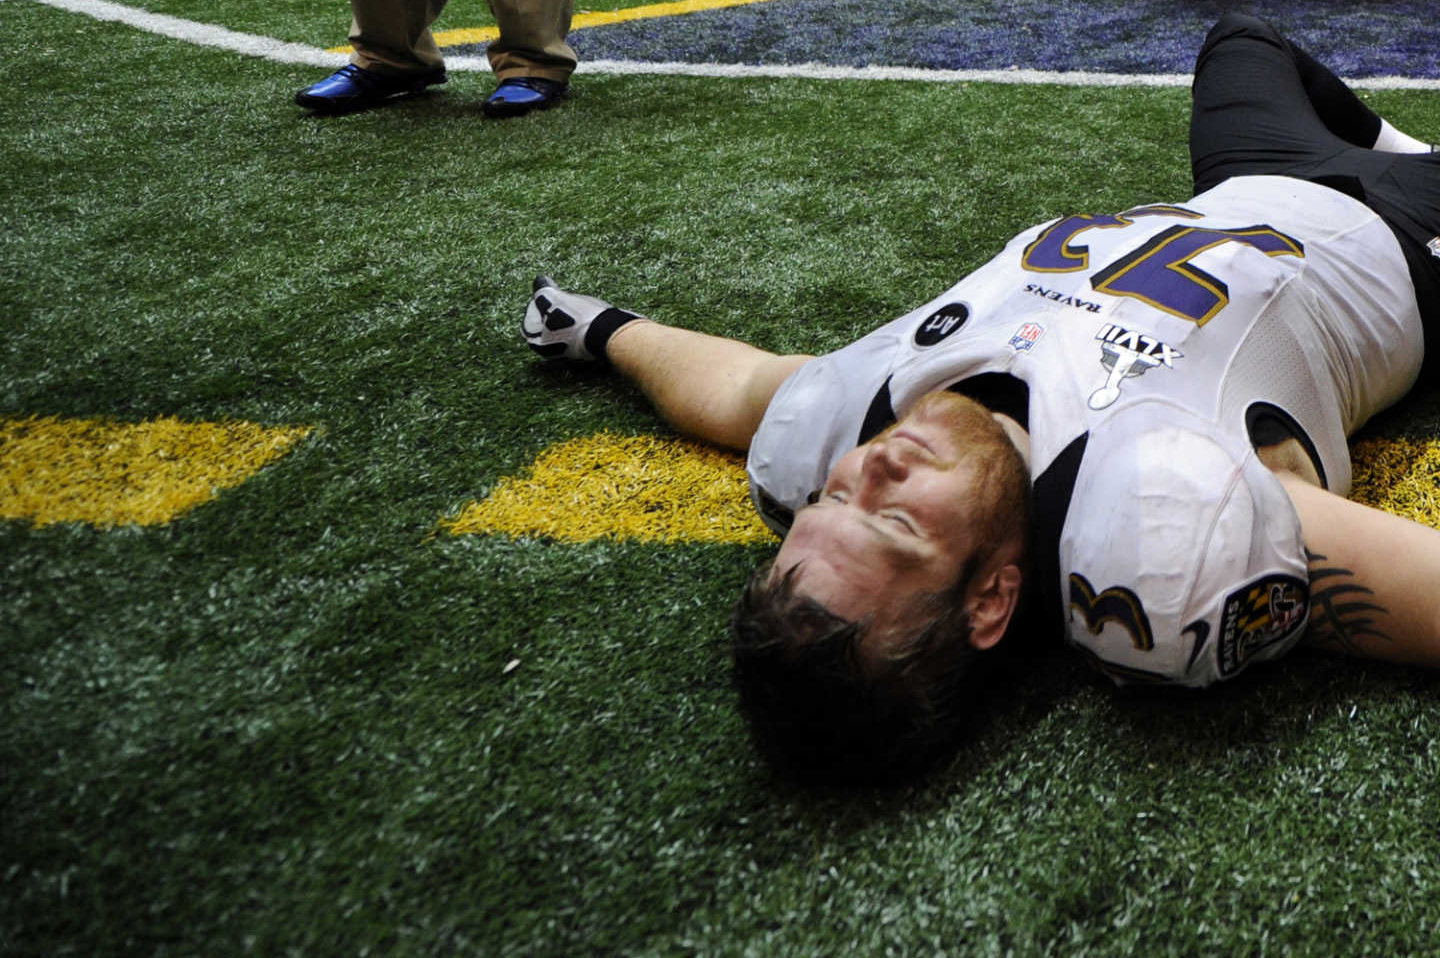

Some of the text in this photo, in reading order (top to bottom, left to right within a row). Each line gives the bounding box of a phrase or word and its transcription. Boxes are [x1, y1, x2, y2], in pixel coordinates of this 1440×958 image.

[1022, 283, 1104, 314] RAVENS
[925, 314, 956, 335] Art
[1017, 322, 1042, 342] NFL
[1095, 322, 1185, 370] XLVII
[1221, 600, 1241, 671] RAVENS
